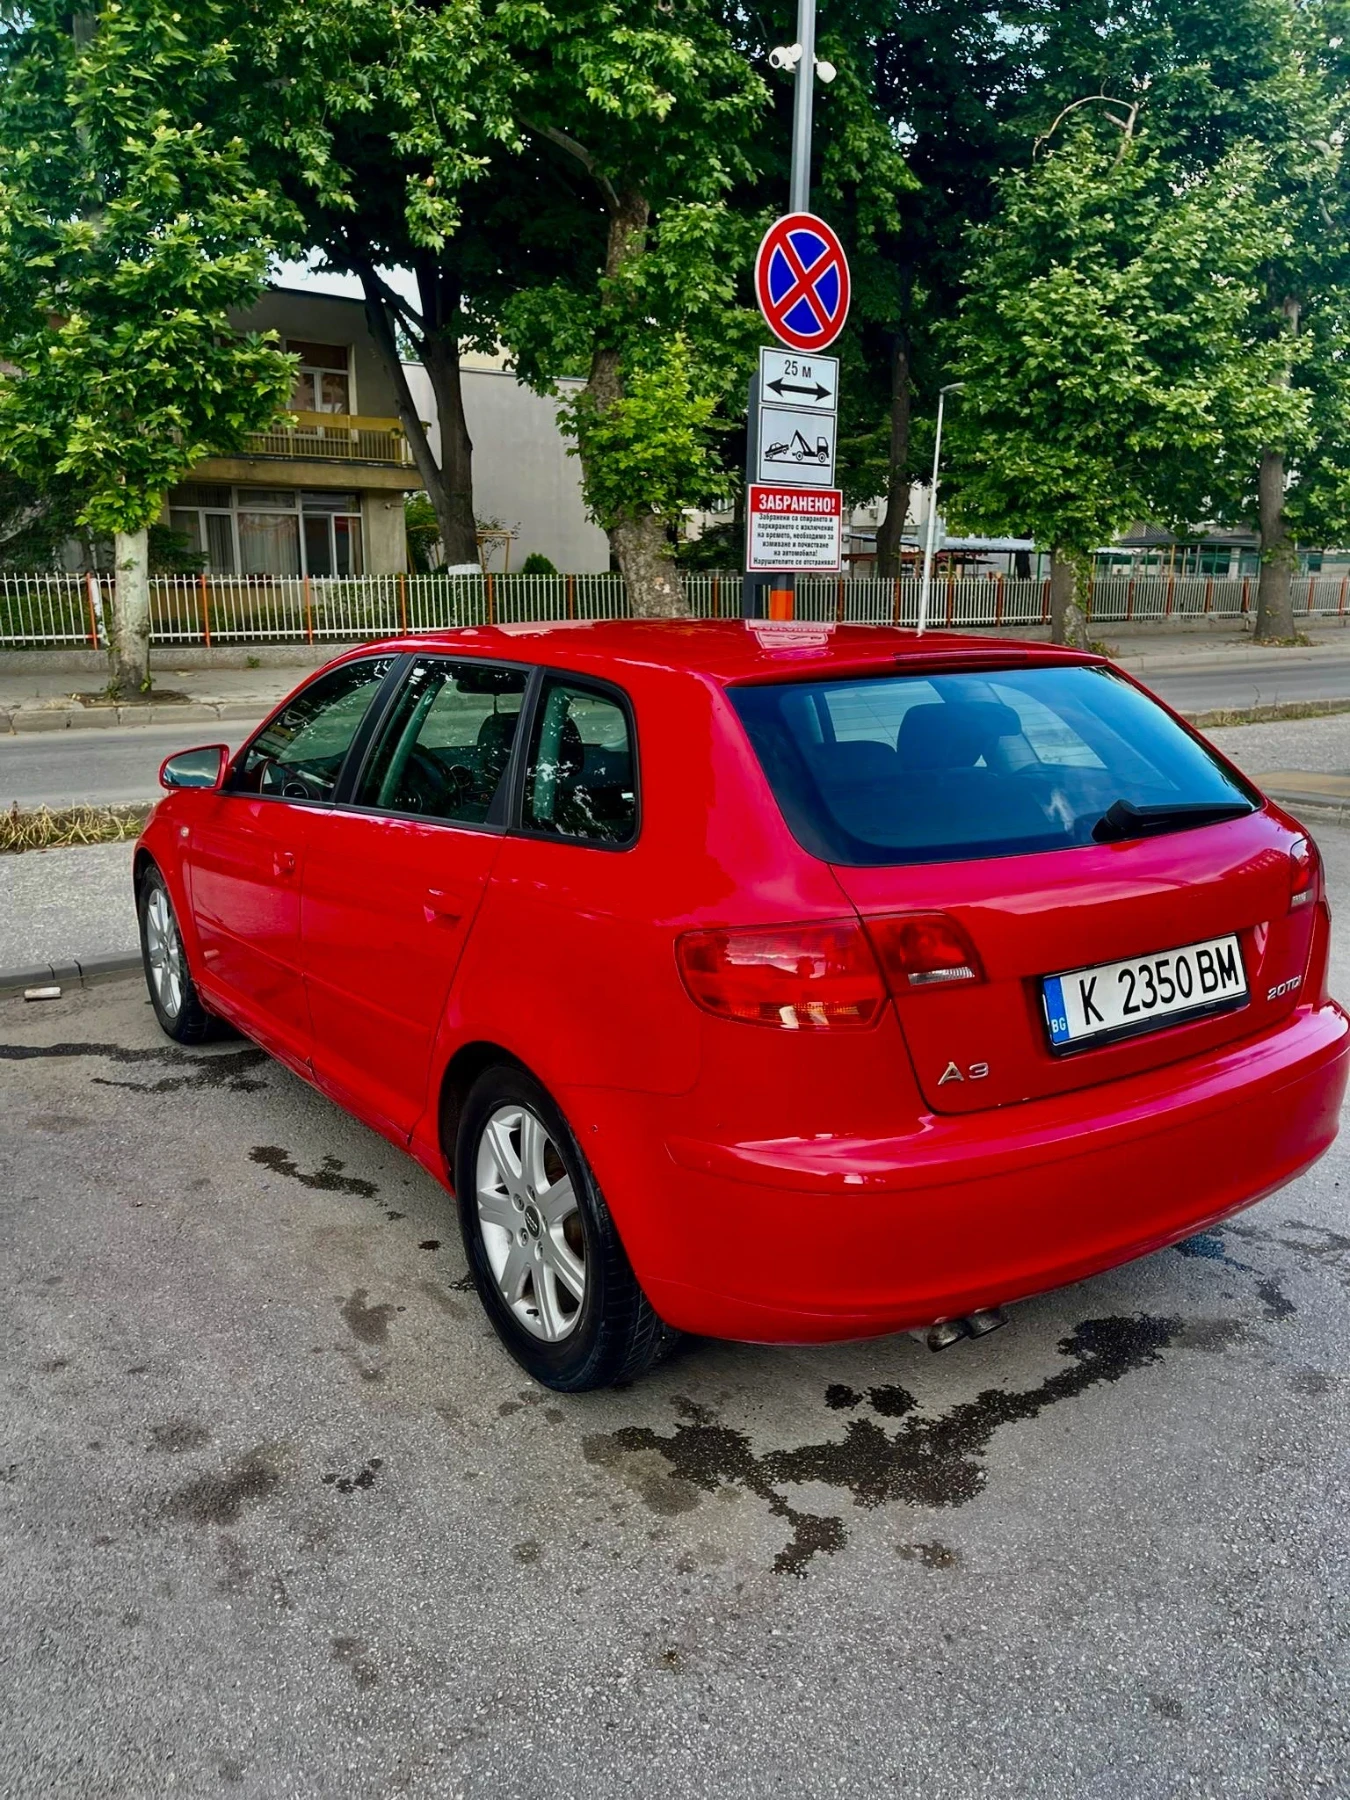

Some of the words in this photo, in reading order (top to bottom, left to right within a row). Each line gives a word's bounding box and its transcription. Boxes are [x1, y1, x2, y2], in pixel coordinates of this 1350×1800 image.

[785, 360, 798, 376] 25
[759, 494, 835, 512] ЗАБРАНЕНО!
[1079, 976, 1104, 1026] K
[1118, 955, 1193, 1016] 2350
[1196, 943, 1240, 994] BM
[1051, 1016, 1067, 1033] BG
[938, 1062, 988, 1085] A3
